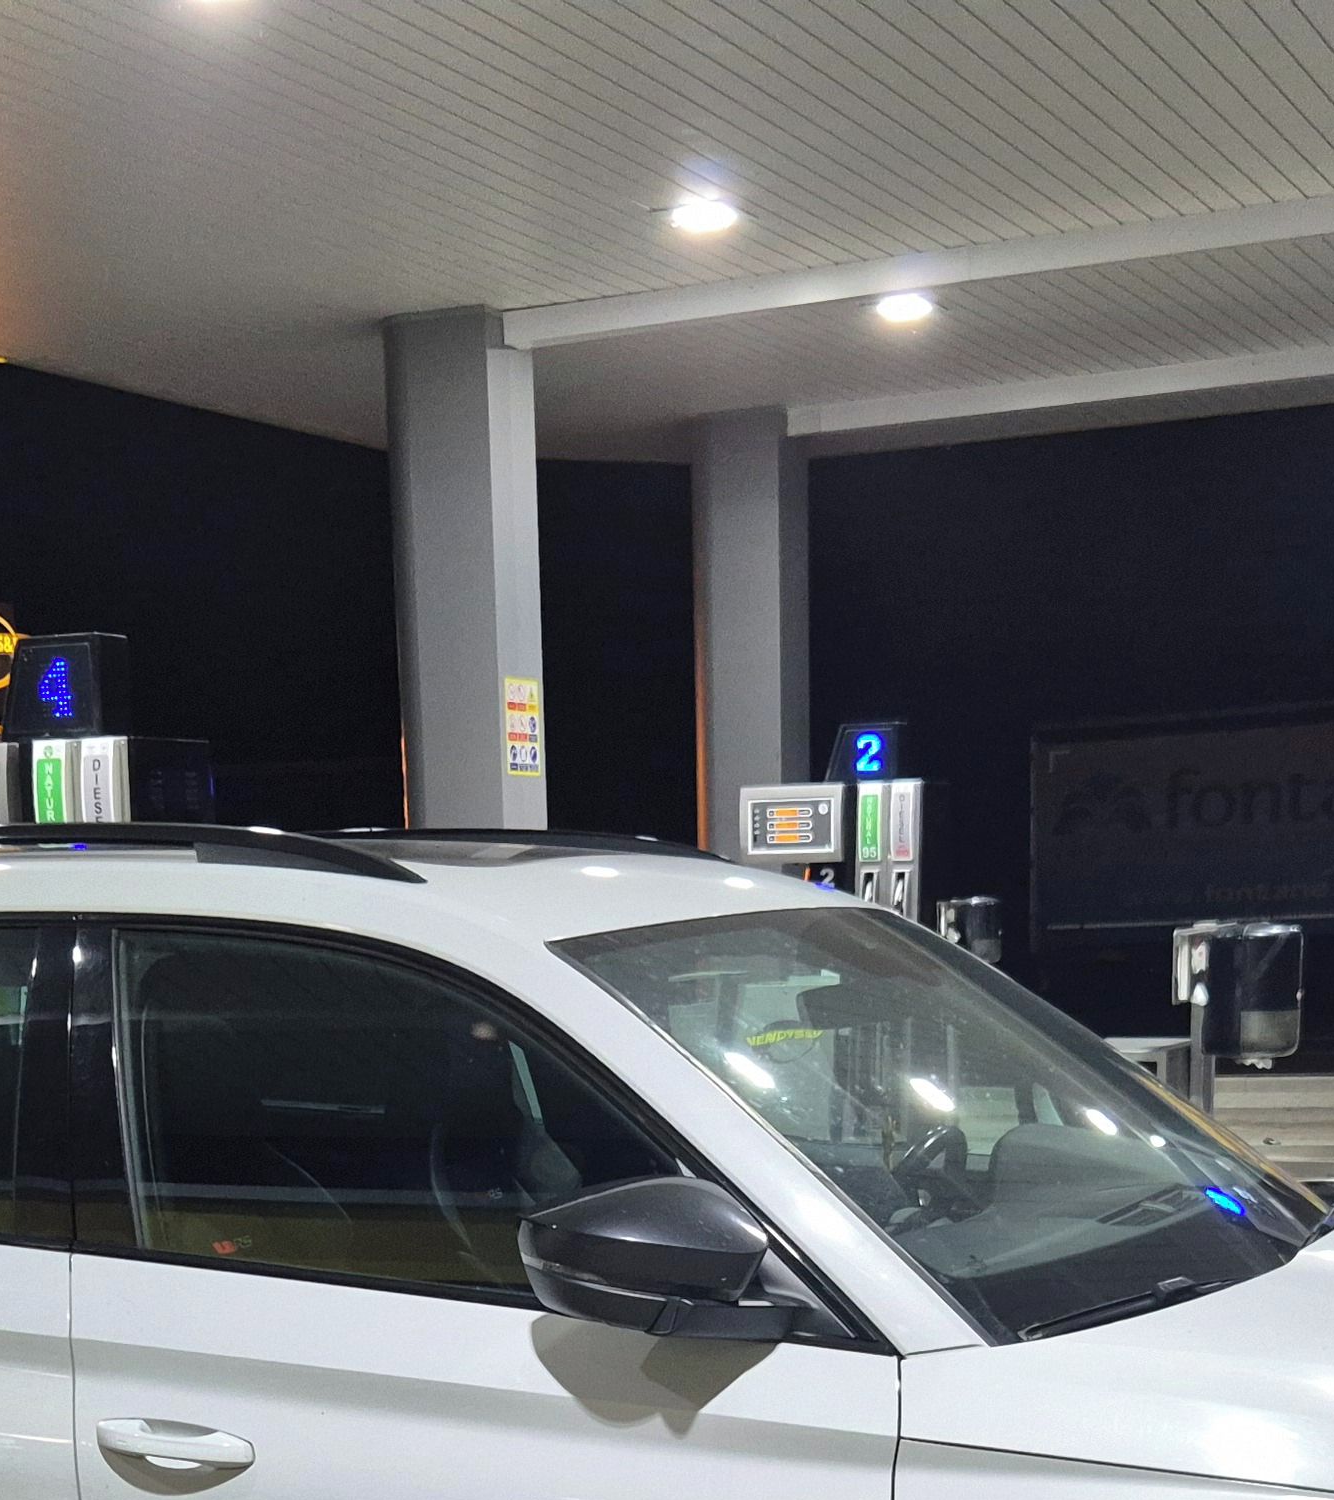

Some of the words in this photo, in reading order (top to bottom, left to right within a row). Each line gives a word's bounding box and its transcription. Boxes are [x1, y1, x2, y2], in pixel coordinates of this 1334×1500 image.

[38, 656, 73, 718] 4
[856, 734, 882, 772] 2
[820, 868, 835, 889] 2
